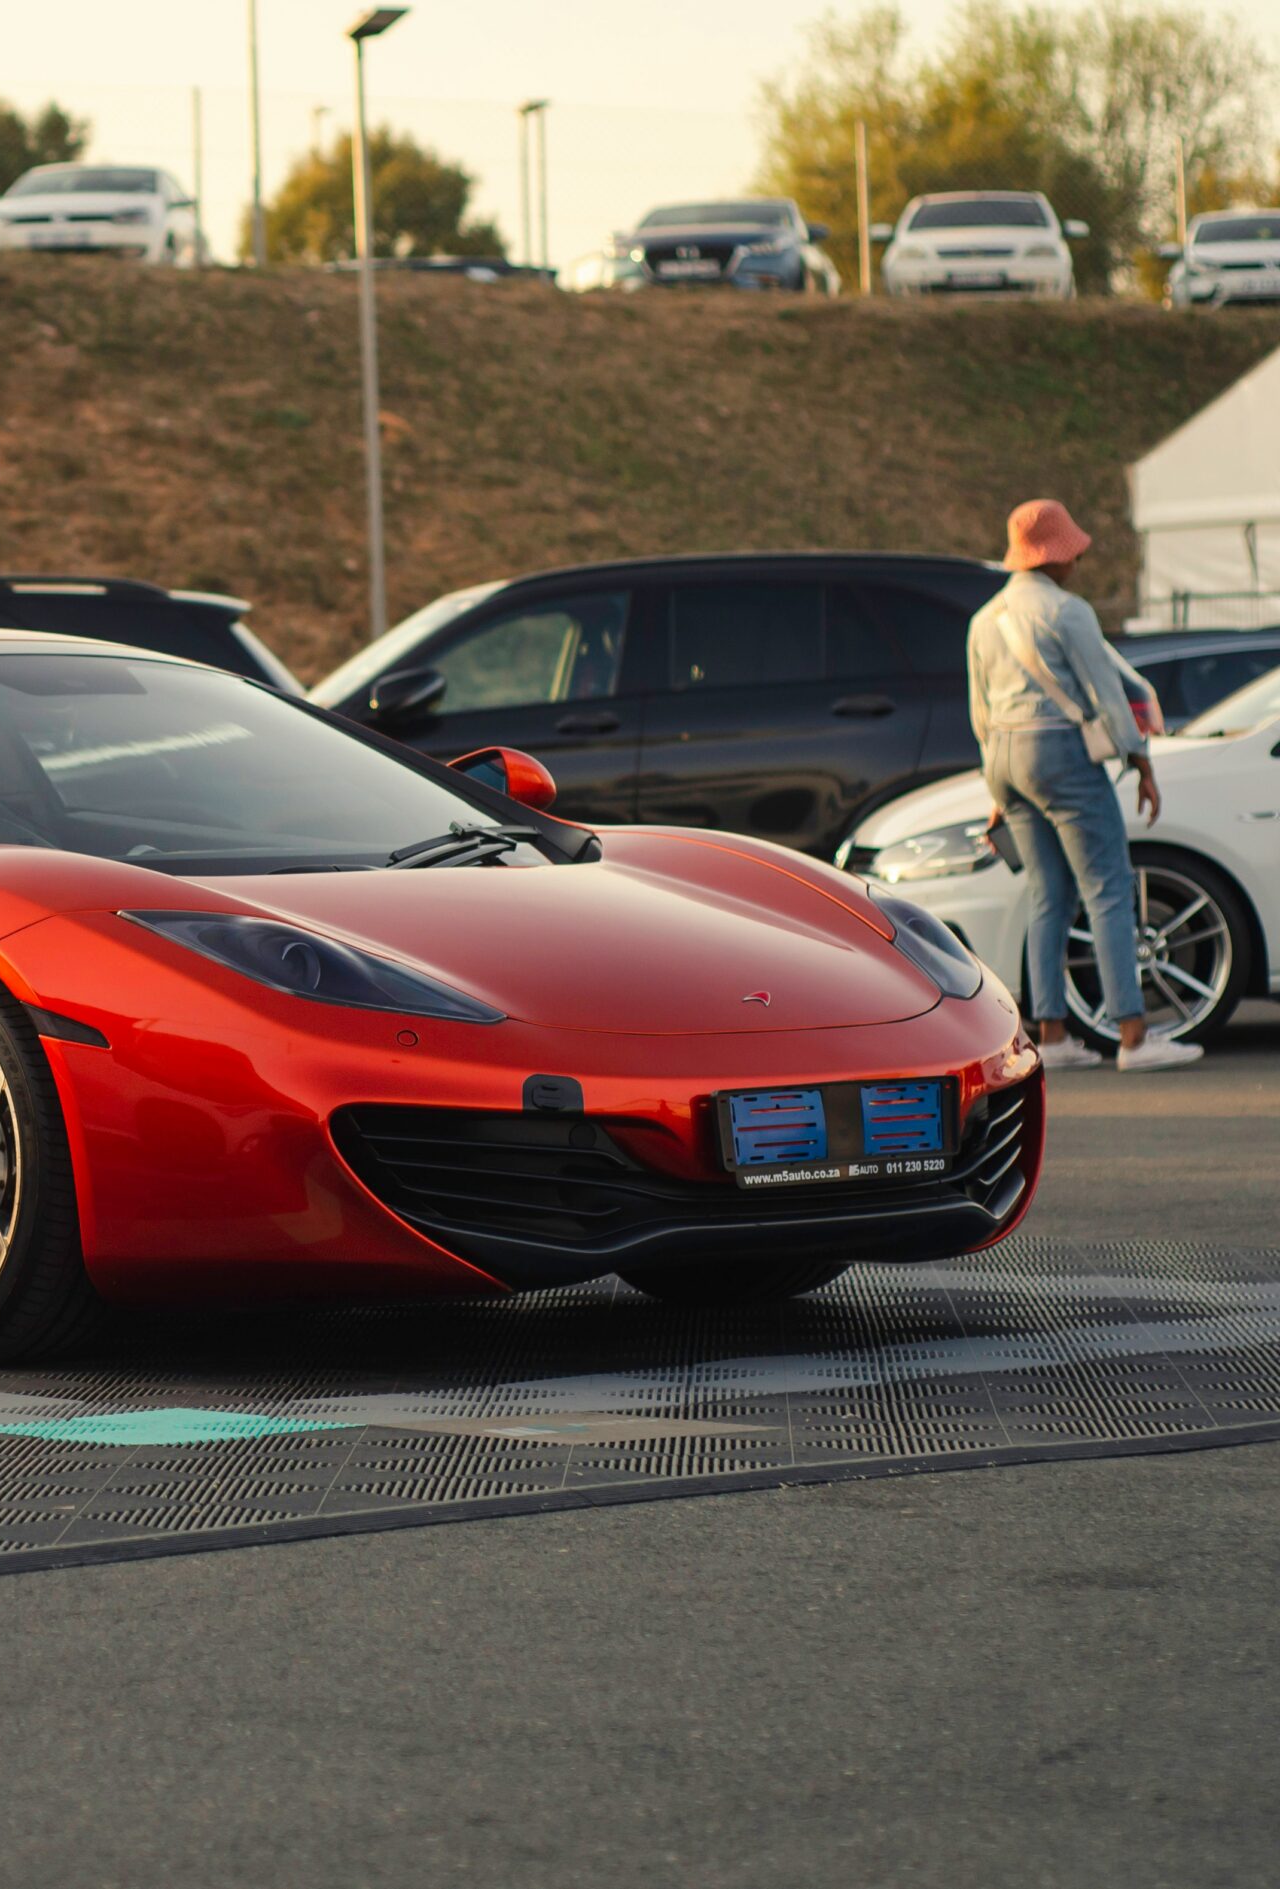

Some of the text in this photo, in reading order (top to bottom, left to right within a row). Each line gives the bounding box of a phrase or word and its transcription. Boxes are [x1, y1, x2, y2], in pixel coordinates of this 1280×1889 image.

[744, 1167, 841, 1185] www.m5auto.co.za
[860, 1164, 879, 1175] AUTO
[886, 1162, 903, 1174] 011
[905, 1160, 921, 1172] 230
[923, 1159, 945, 1171] 5220
